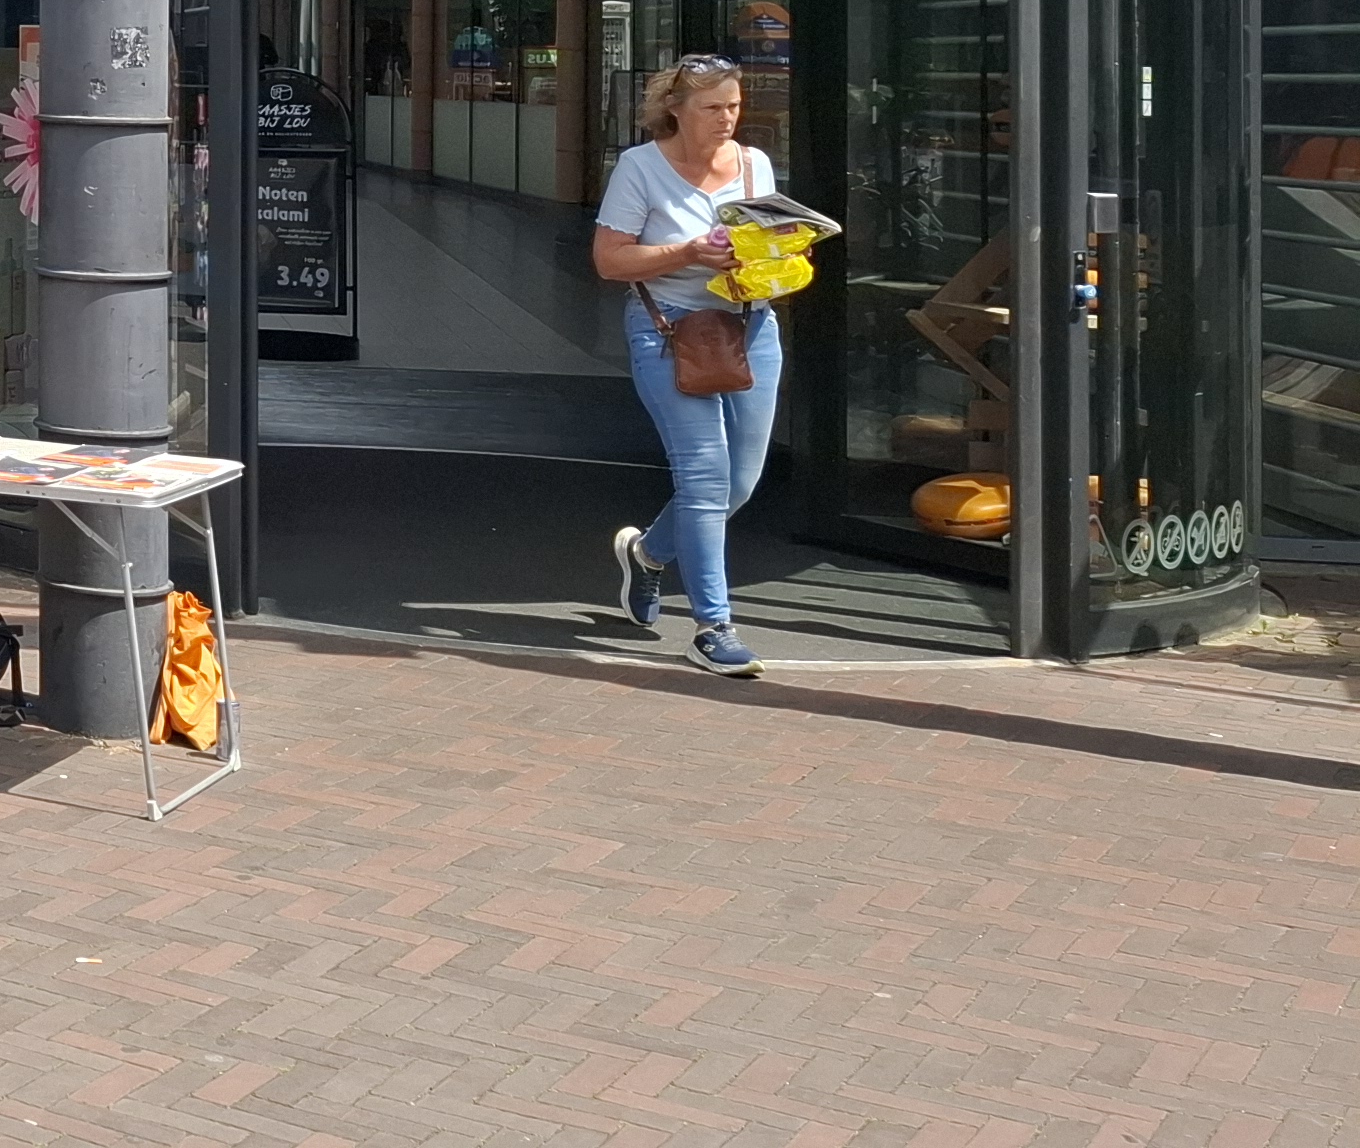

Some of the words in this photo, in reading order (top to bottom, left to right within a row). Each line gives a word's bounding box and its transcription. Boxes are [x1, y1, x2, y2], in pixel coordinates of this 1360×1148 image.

[283, 118, 311, 128] LOU
[258, 185, 308, 202] Noten
[276, 265, 330, 288] 3.49
